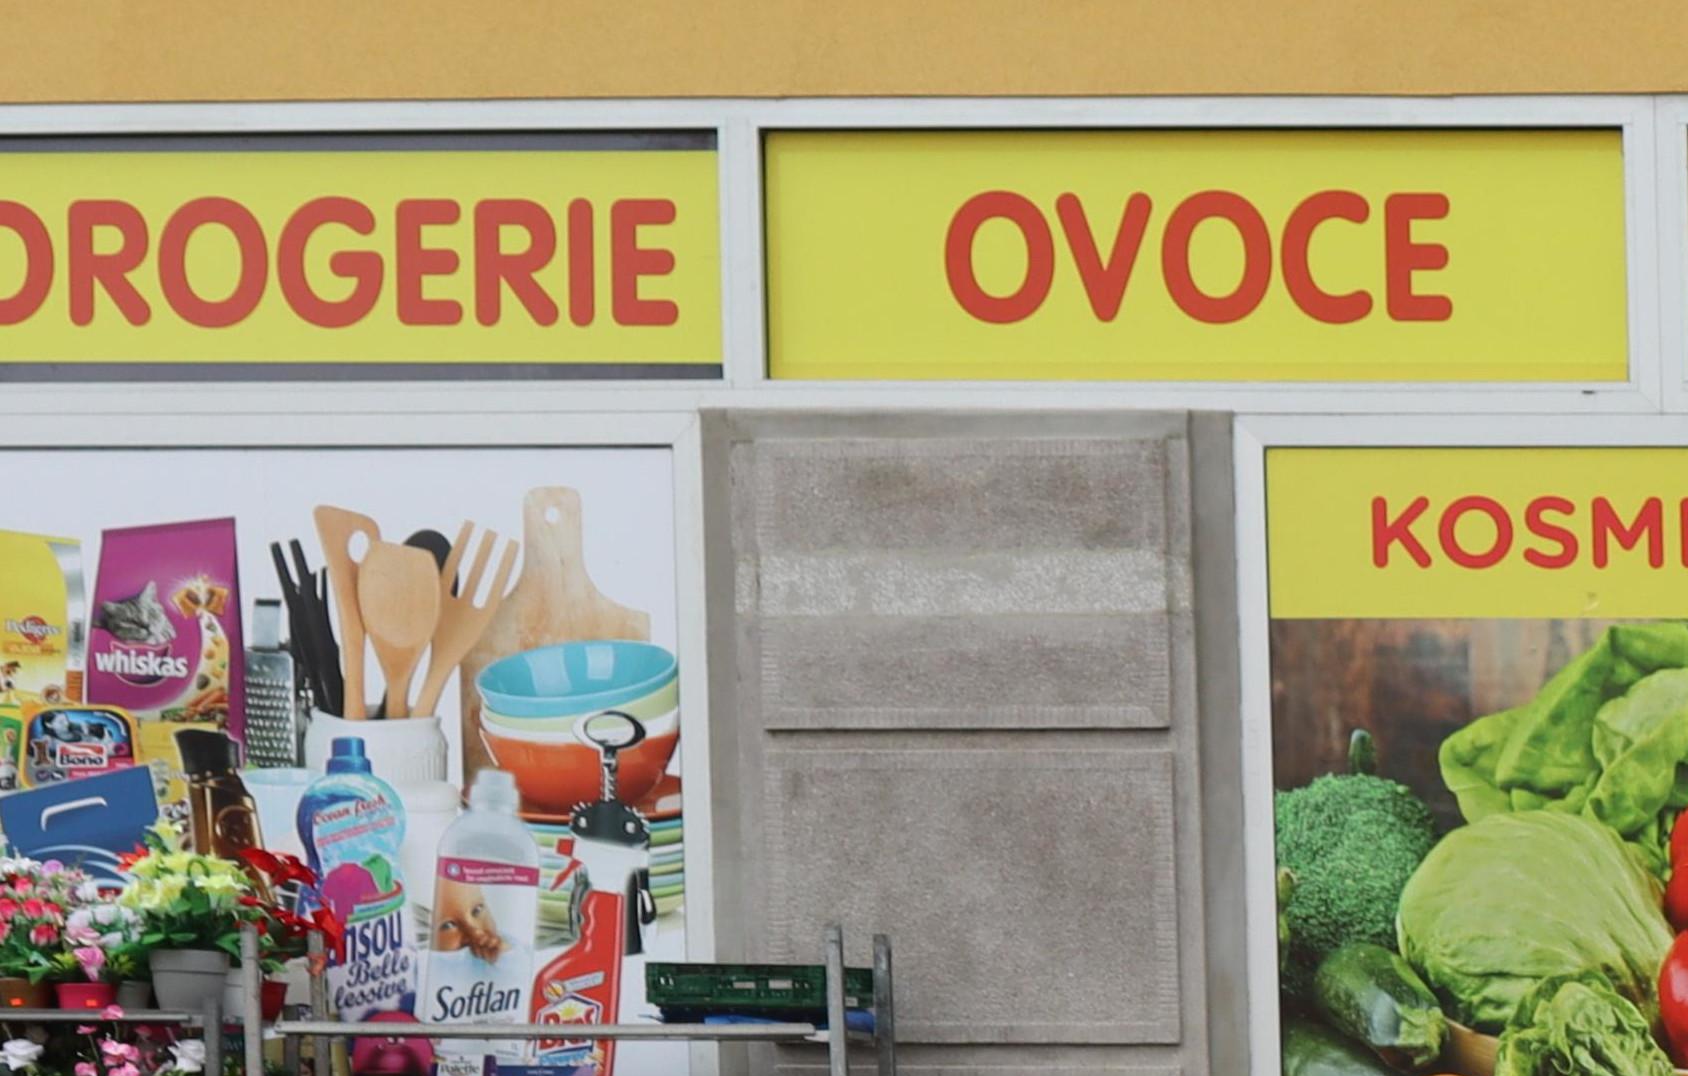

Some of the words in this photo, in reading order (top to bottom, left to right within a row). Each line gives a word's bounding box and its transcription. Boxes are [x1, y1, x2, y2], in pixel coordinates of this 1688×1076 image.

[944, 189, 1453, 325] OVOCE
[95, 649, 189, 678] whiskas
[432, 982, 520, 1022] Softlan
